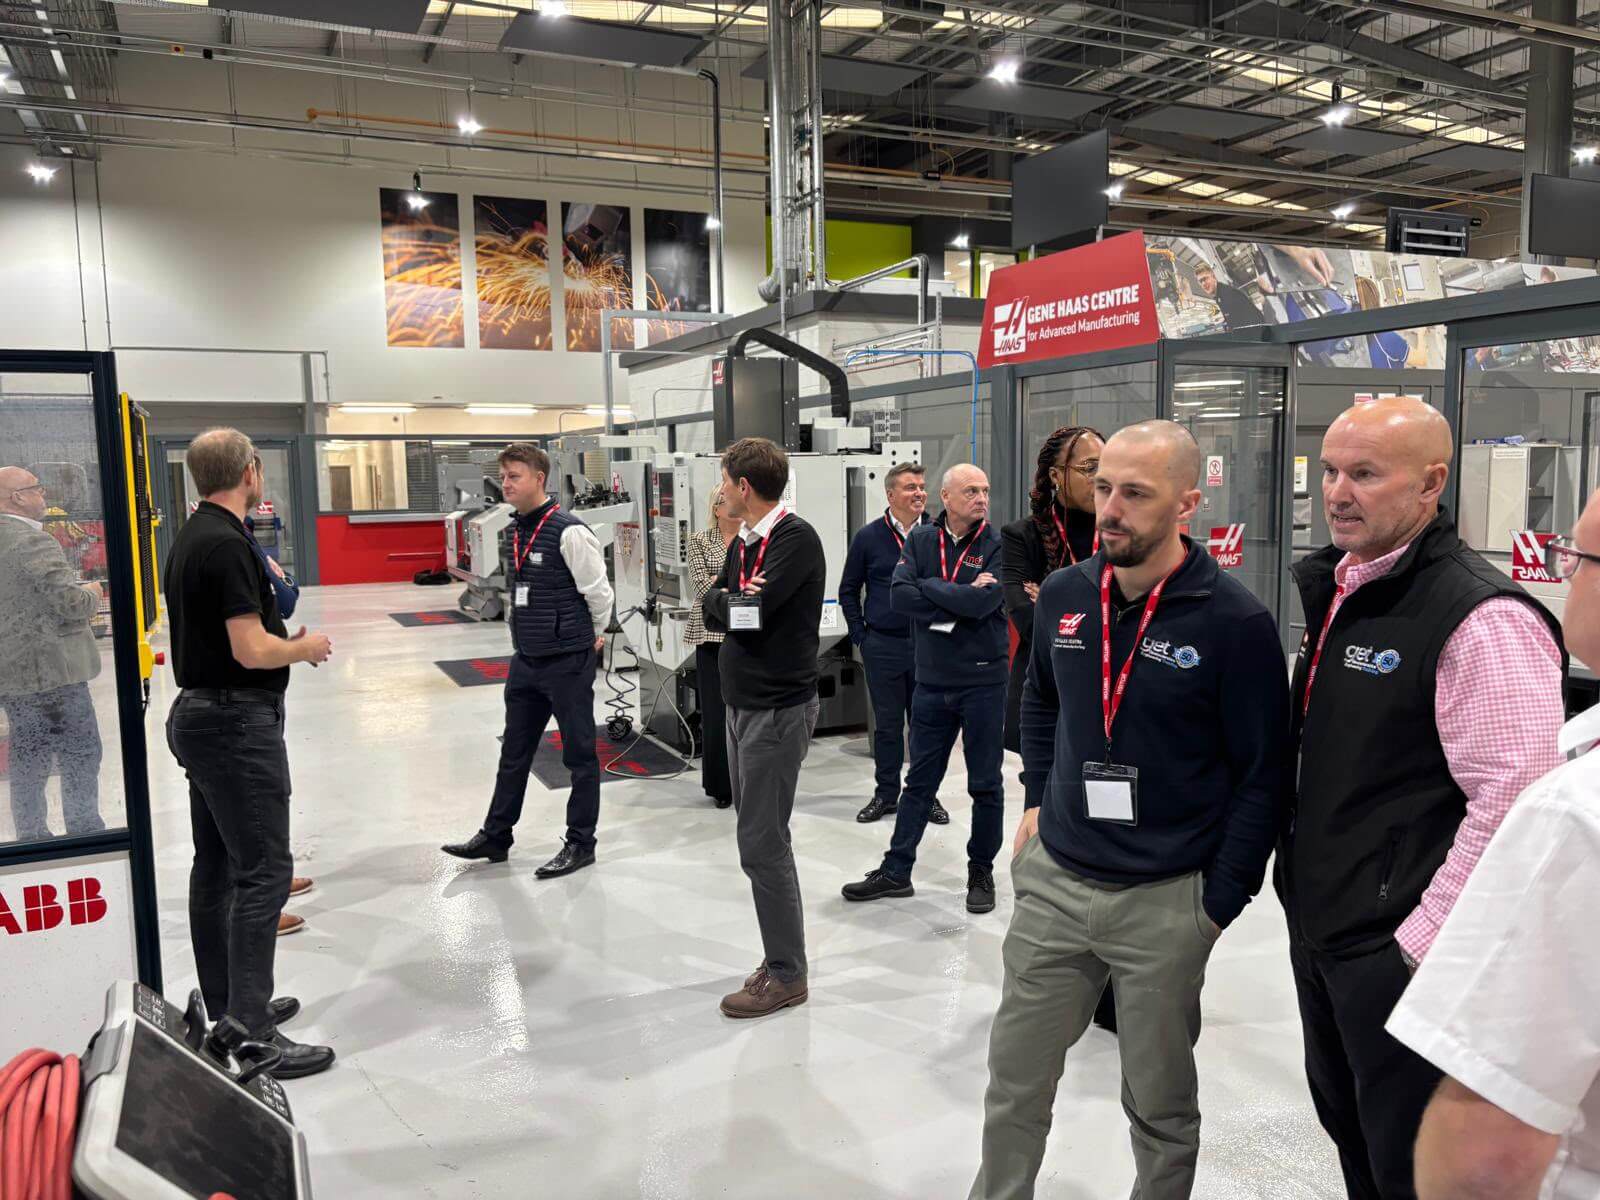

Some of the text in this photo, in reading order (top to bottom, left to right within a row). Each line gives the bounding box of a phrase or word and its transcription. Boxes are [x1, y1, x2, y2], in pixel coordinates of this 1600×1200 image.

[1027, 284, 1140, 325] GENE HAAS CENTRE
[1027, 311, 1140, 342] for Advanced Manufacturing
